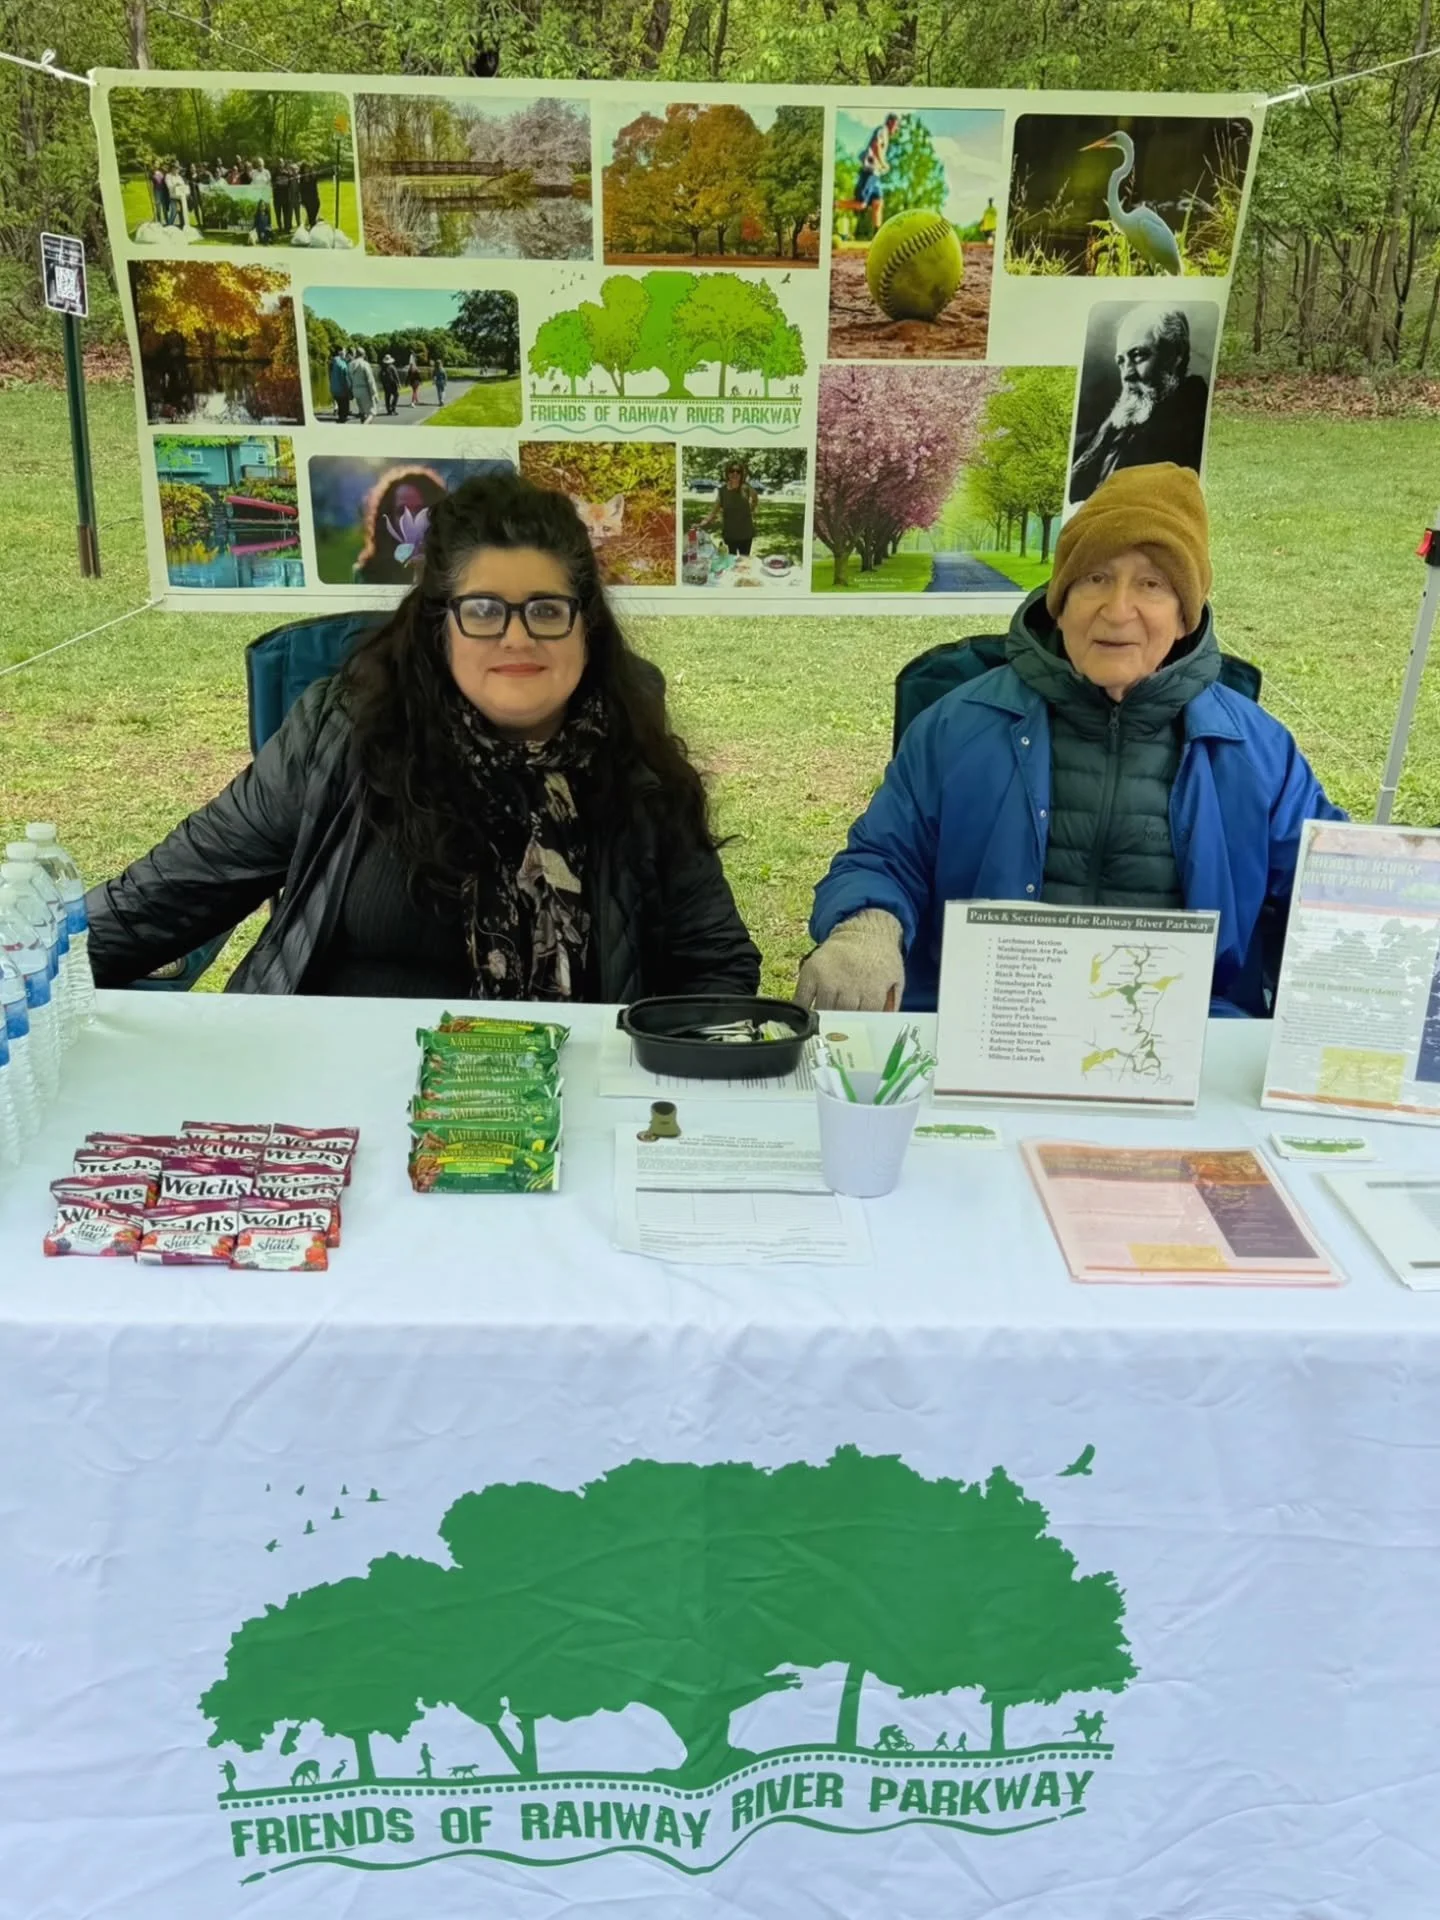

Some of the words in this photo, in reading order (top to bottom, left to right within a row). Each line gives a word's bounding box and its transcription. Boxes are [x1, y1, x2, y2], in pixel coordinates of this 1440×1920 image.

[530, 404, 586, 422] FRIENDS
[594, 405, 611, 422] OF
[618, 405, 679, 423] RAHWAY
[686, 406, 725, 424] RIVER
[732, 407, 802, 425] PARKWAY
[969, 910, 1000, 922] Parks
[1001, 912, 1010, 922] &
[1011, 912, 1057, 925] Sections
[1058, 914, 1071, 925] of
[1072, 914, 1090, 926] the
[1092, 915, 1133, 930] Rahway
[1135, 917, 1164, 929] River
[1166, 918, 1211, 933] Parkway
[447, 1129, 483, 1143] NATURE
[485, 1130, 519, 1145] VALLEY
[163, 1175, 249, 1198] Welch's
[230, 1806, 416, 1857] FRIENDS
[440, 1805, 494, 1845] OF
[520, 1801, 712, 1850] RAHWAY
[731, 1771, 845, 1832] RIVER
[868, 1770, 1095, 1816] PARKWAY
